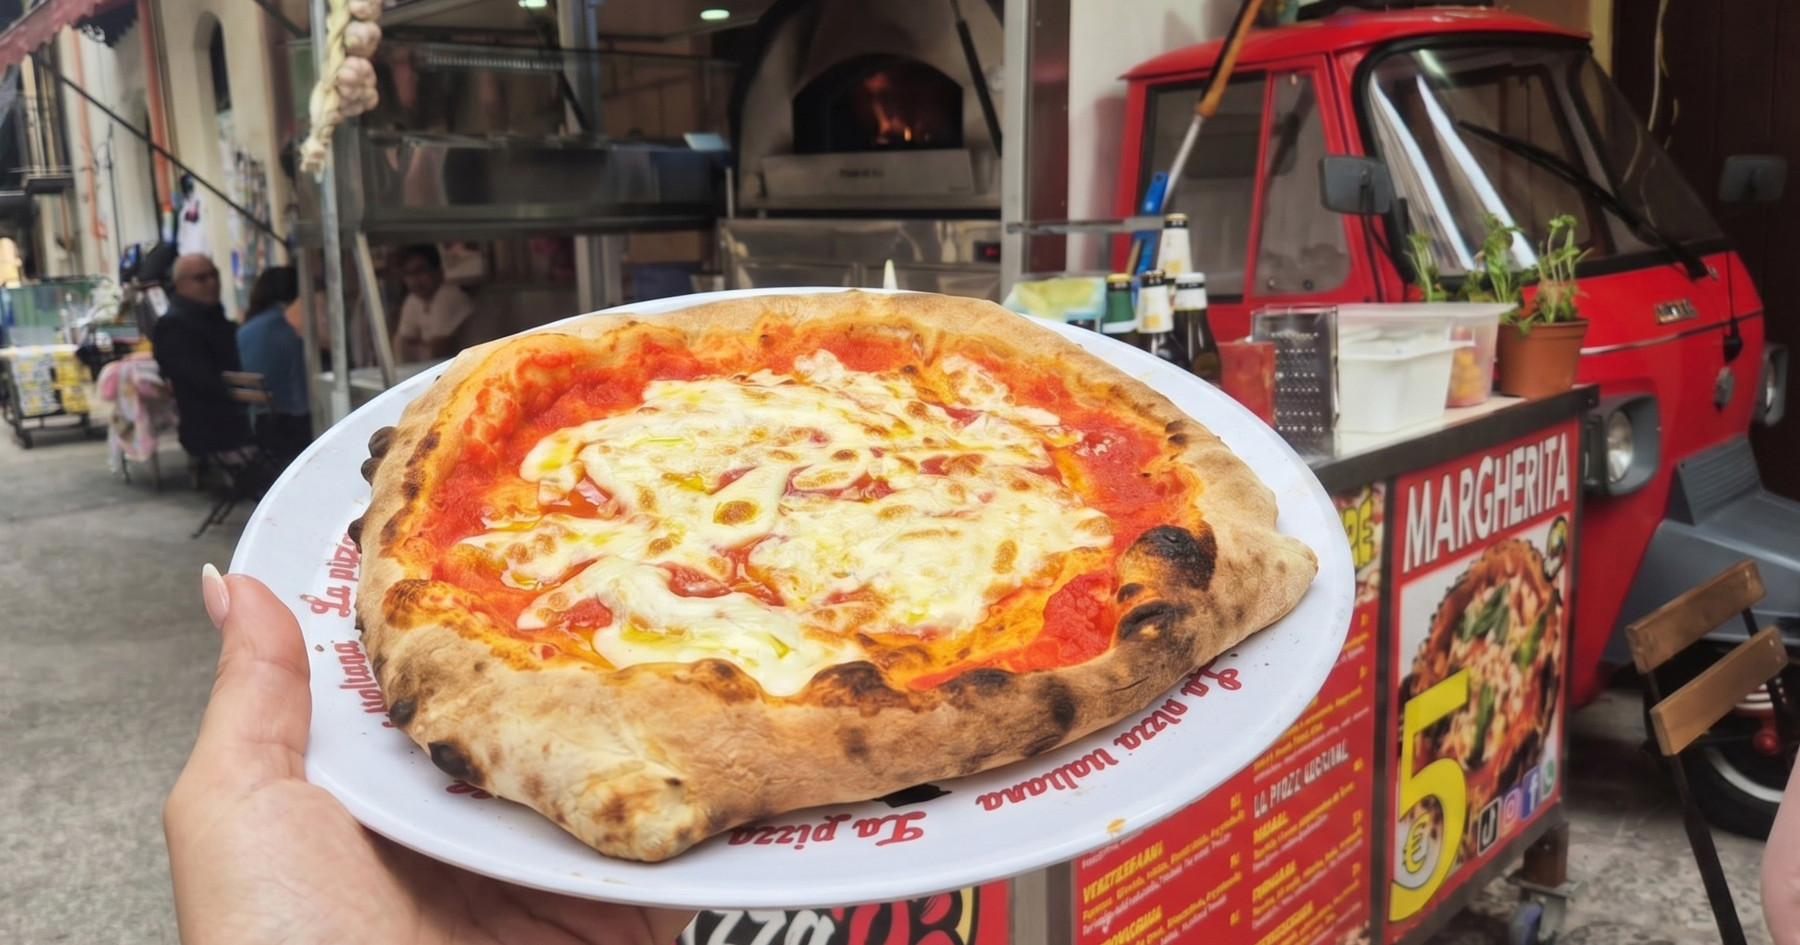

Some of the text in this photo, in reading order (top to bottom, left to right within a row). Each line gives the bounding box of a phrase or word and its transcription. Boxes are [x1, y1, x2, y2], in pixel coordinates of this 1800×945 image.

[1403, 432, 1570, 574] MARGHERITA
[300, 586, 350, 618] La
[728, 811, 927, 850] La pizza
[1389, 666, 1470, 922] 5
